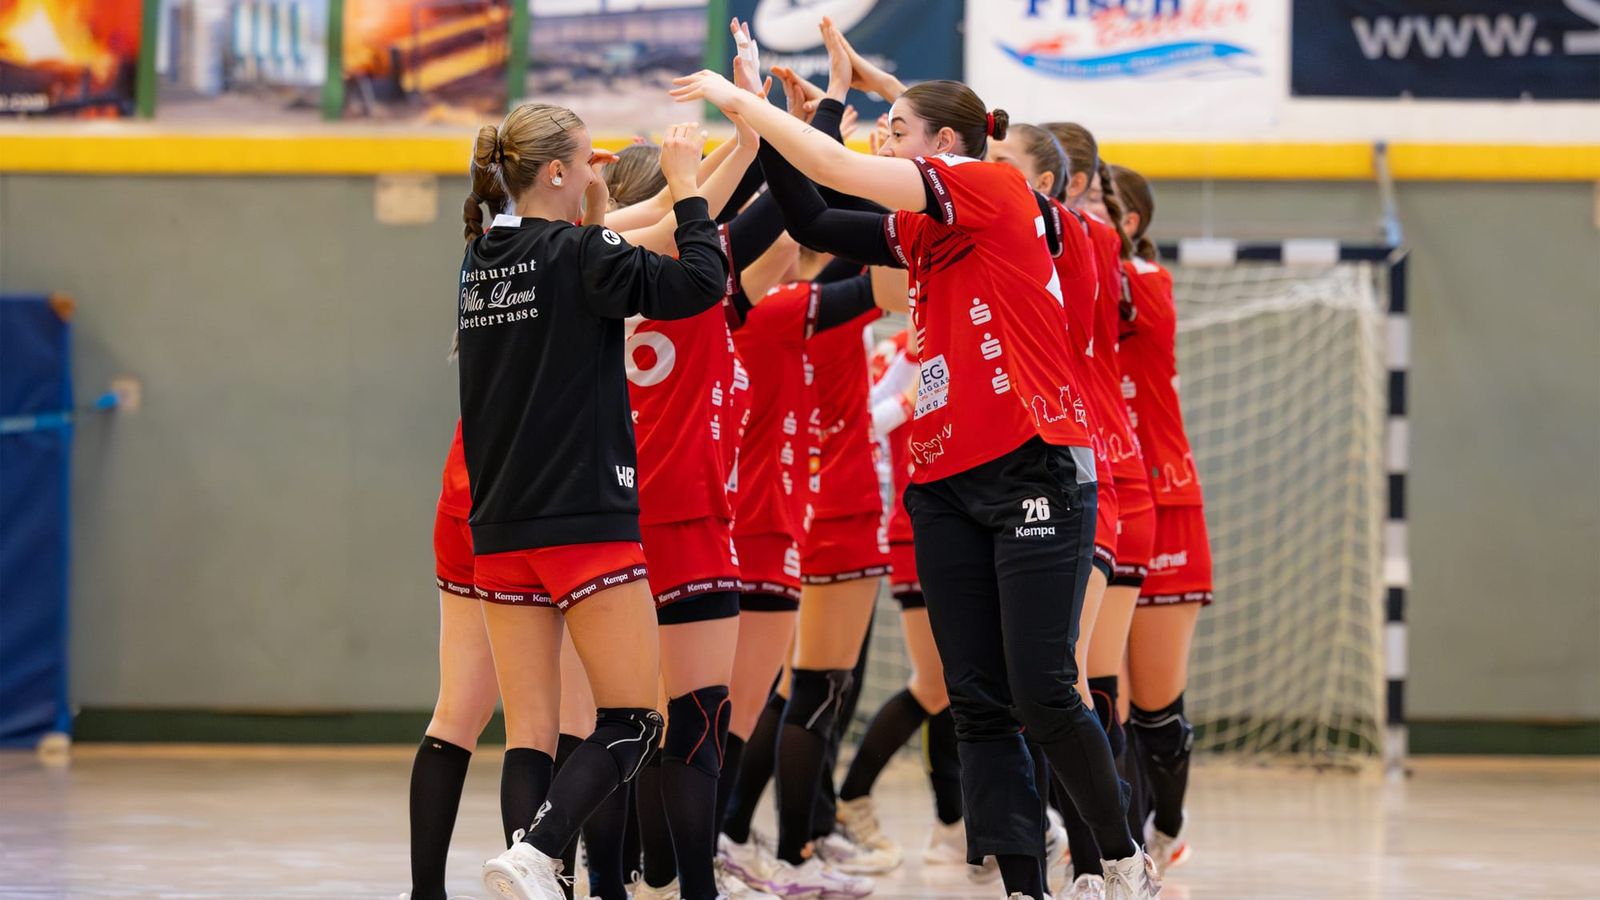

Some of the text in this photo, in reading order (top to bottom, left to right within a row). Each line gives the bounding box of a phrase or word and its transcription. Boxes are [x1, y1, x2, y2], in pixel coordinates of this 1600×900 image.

[927, 167, 954, 226] Kempa Kemp
[894, 245, 909, 267] Kemp
[461, 259, 537, 284] Restaurant
[460, 280, 536, 315] Villa Lacus
[459, 307, 539, 330] Seeterrasse
[615, 465, 635, 488] HB
[1022, 496, 1050, 523] 26
[1015, 526, 1056, 538] Kempa
[447, 581, 470, 595] Kempa
[494, 591, 524, 603] Kempa
[570, 583, 597, 601] Kempa
[603, 573, 629, 586] Kempa
[658, 589, 681, 604] Kempa
[687, 581, 713, 593] Kempa
